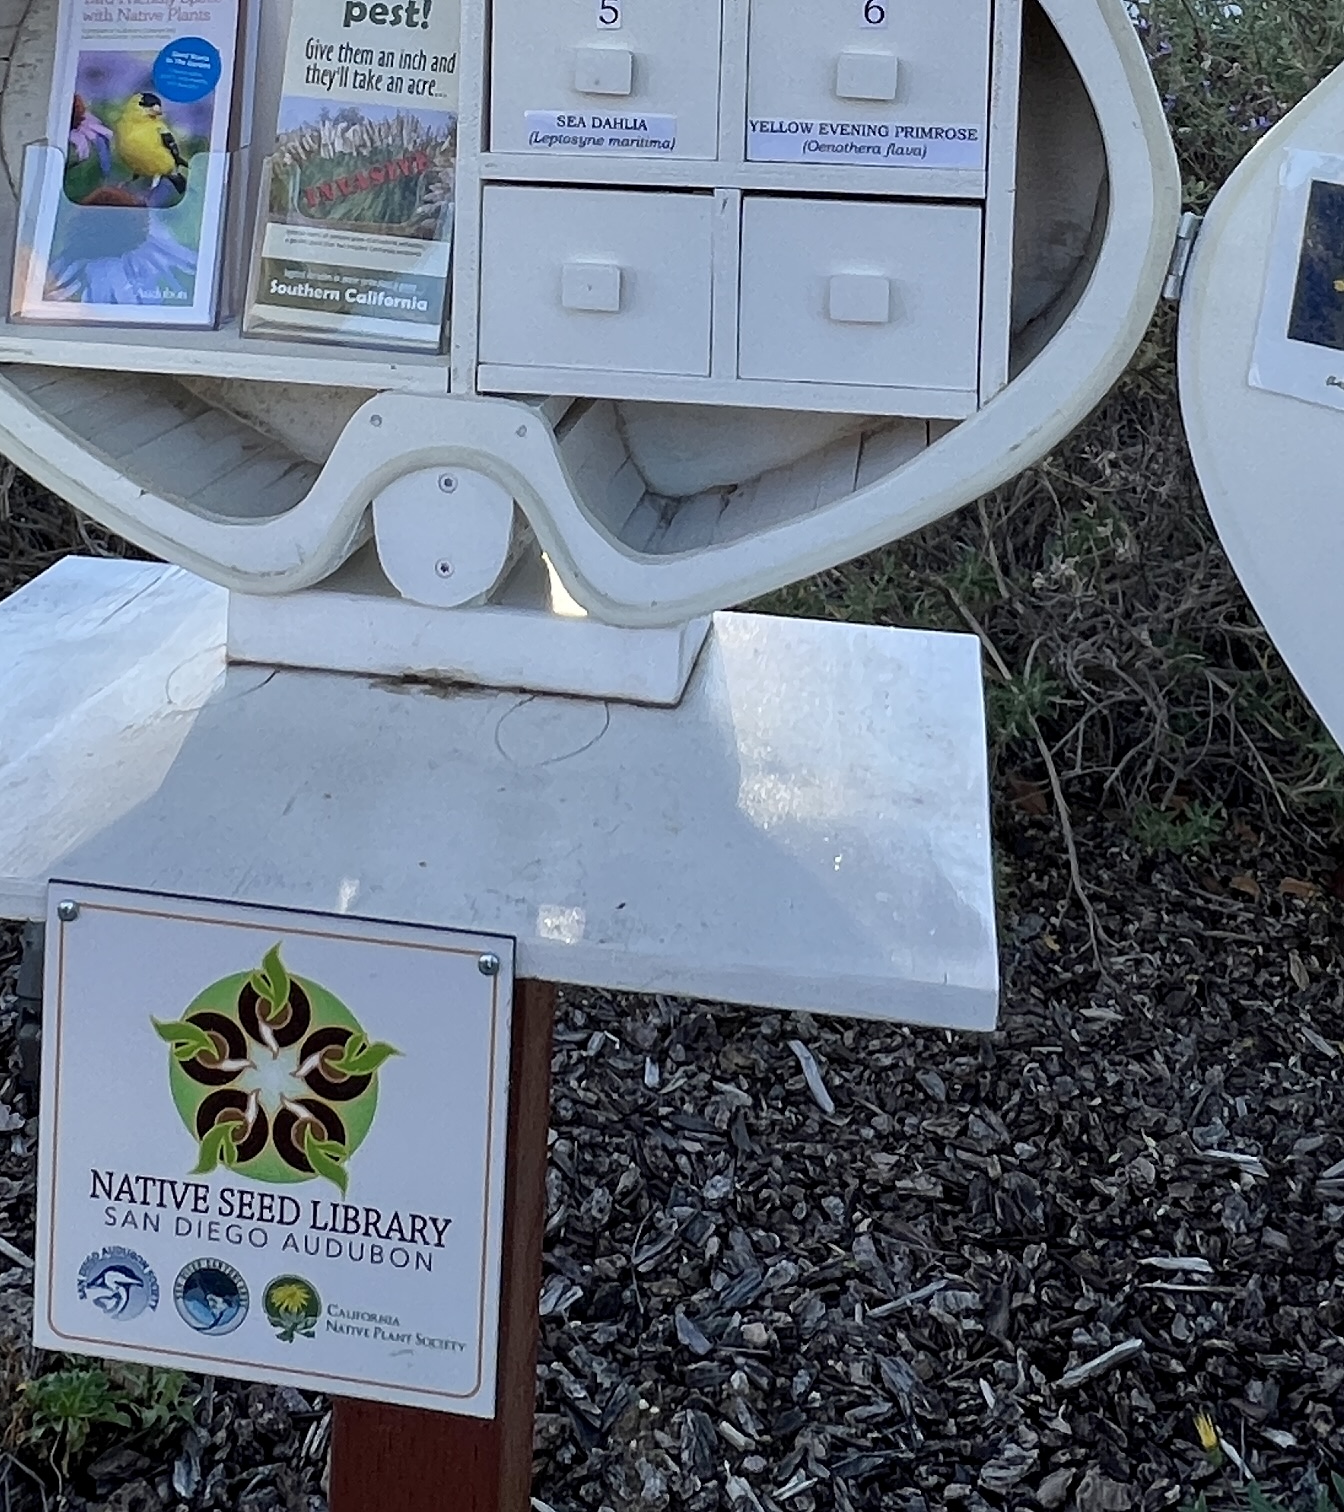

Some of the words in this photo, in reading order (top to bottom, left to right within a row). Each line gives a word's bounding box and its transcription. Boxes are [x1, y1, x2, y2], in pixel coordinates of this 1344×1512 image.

[83, 7, 113, 22] with
[117, 8, 163, 22] Native
[168, 9, 211, 22] Plants
[343, 0, 433, 30] pest!
[306, 37, 334, 62] Give
[338, 42, 373, 66] them
[378, 49, 395, 68] an
[399, 48, 427, 71] inch
[431, 51, 456, 74] and
[306, 63, 350, 91] they'll
[352, 69, 383, 91] take
[387, 75, 403, 94] an
[408, 77, 447, 98] acre...
[557, 115, 586, 128] SEA
[592, 117, 647, 131] DAHLIA
[749, 120, 813, 134] YELLOW
[819, 123, 888, 137] EVENING
[894, 126, 978, 140] PRIMROSE
[529, 131, 604, 148] (Leptosyne
[608, 137, 676, 151] maritima)
[803, 139, 881, 155] (Oenothera
[883, 143, 927, 159] flava)
[305, 151, 429, 208] INVASIVE
[270, 279, 340, 301] Southern
[344, 288, 429, 311] California
[90, 1169, 210, 1214] NATIVE
[218, 1187, 301, 1226] SEED
[310, 1199, 452, 1249] LIBRARY
[104, 1206, 161, 1232] SAN
[175, 1215, 269, 1249] DIEGO
[281, 1232, 433, 1272] AUDUBON
